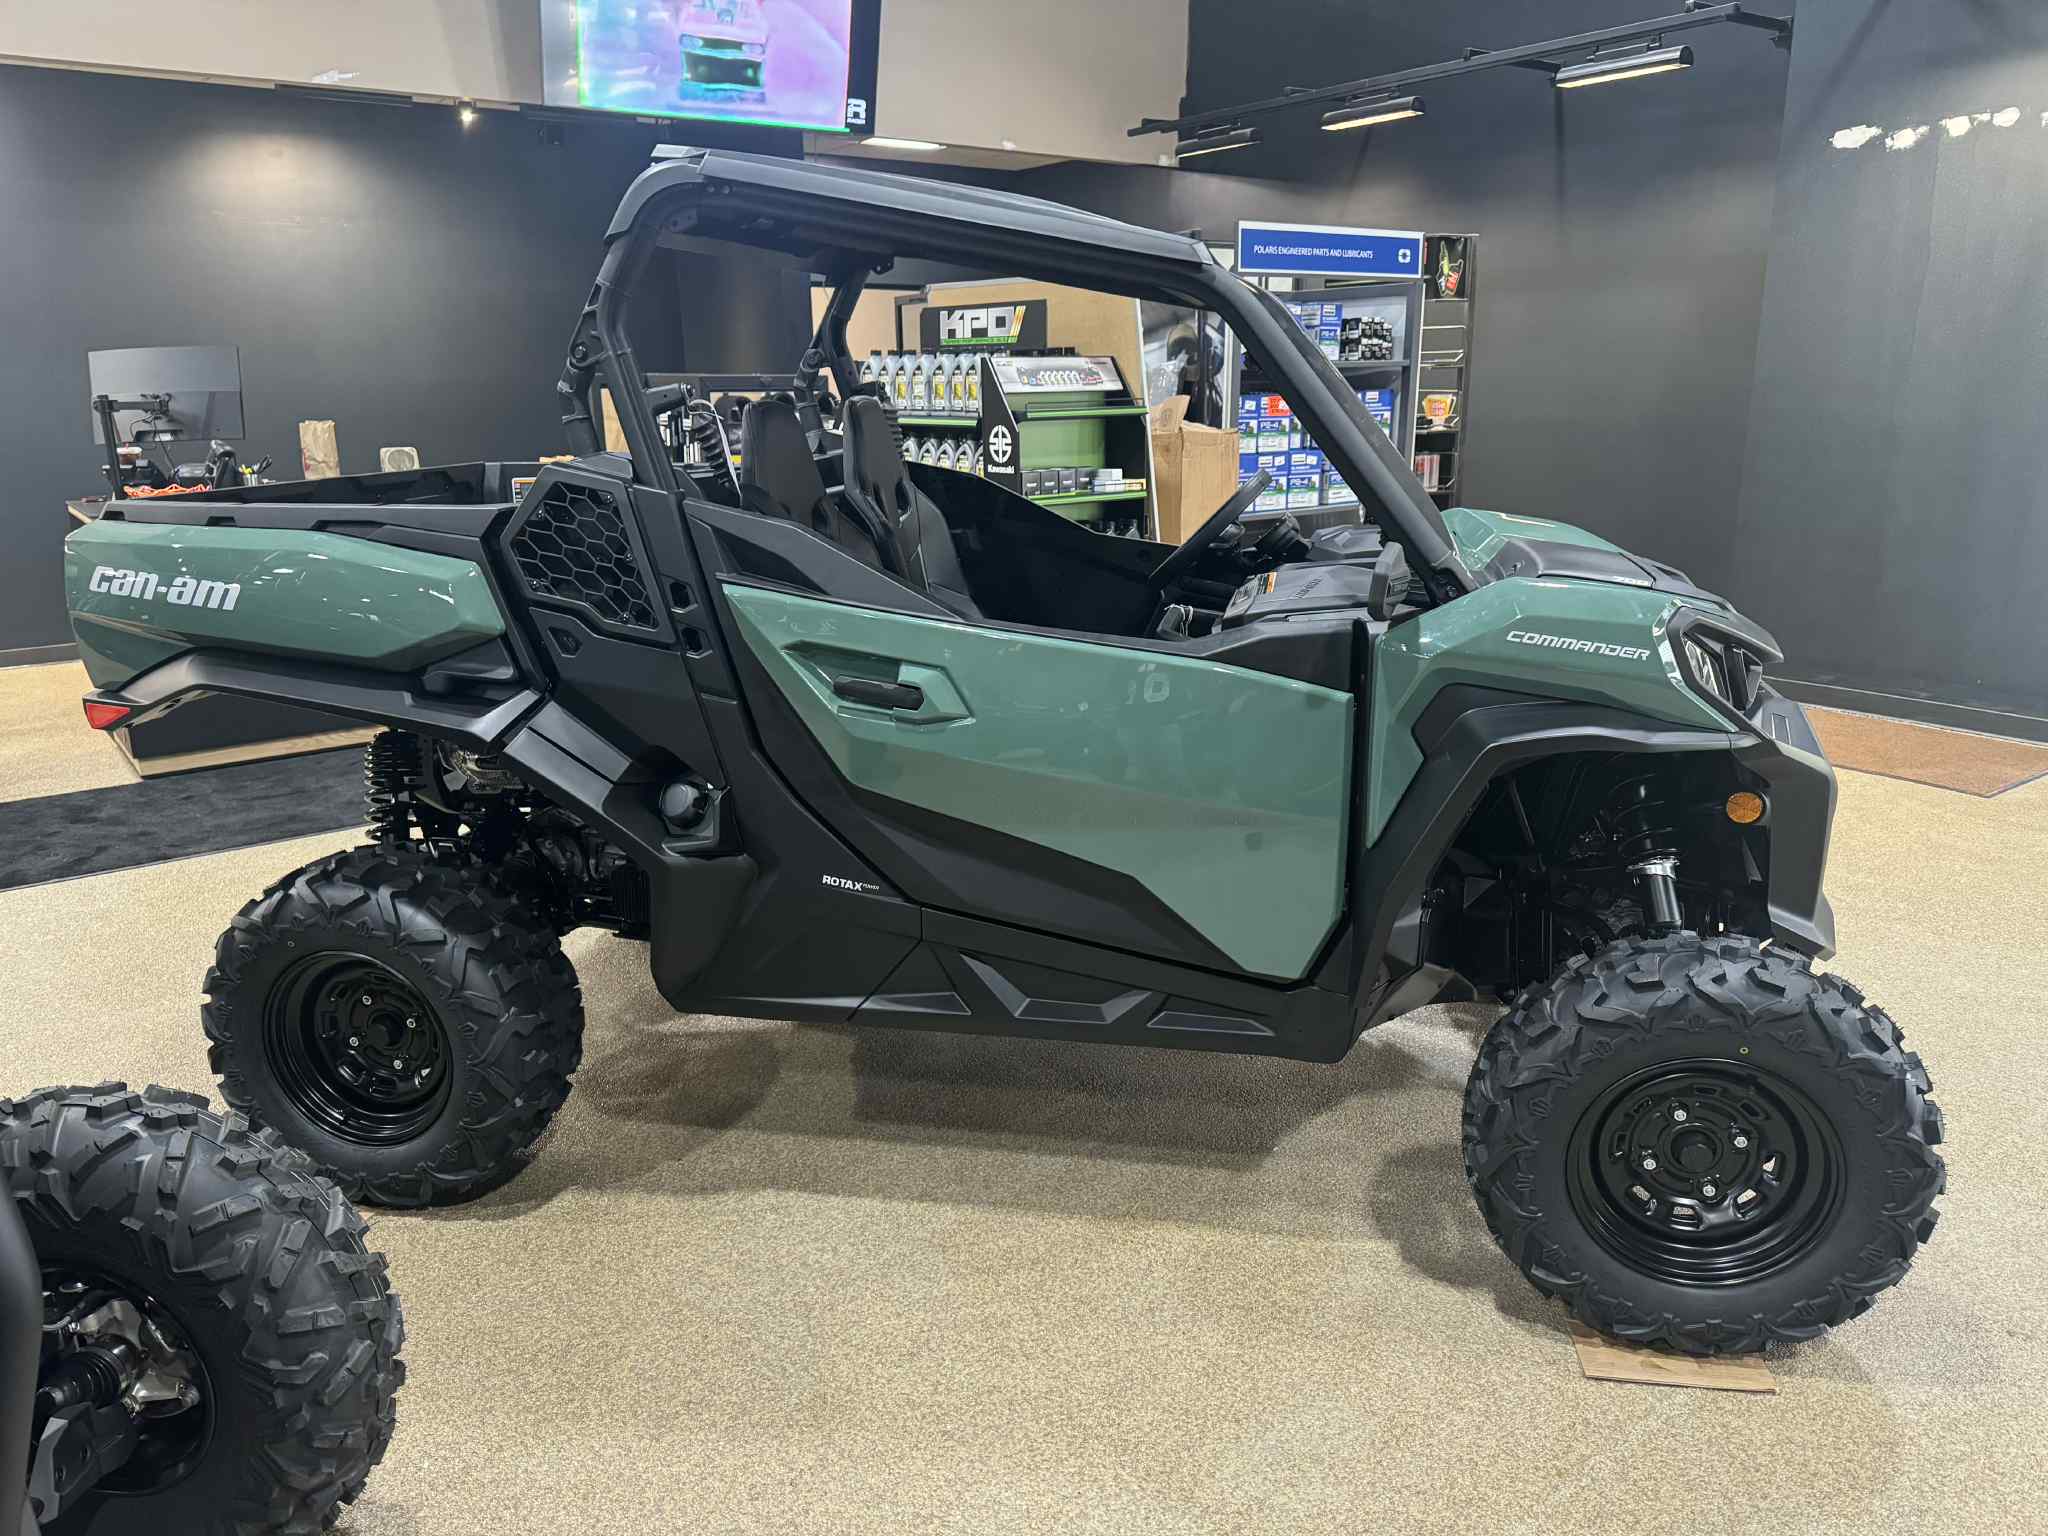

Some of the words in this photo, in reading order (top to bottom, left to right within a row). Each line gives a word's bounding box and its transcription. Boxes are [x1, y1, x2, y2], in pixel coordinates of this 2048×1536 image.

[1253, 244, 1278, 255] POLARIS
[1278, 246, 1313, 256] ENGINEERED
[1313, 247, 1330, 257] PARTS
[1330, 248, 1342, 257] AND
[1342, 249, 1373, 259] LUBRICANTS
[939, 306, 1015, 339] KPO
[987, 464, 1015, 474] Kawasaki
[1506, 630, 1651, 661] COMMANDER
[822, 874, 863, 891] ROTAX
